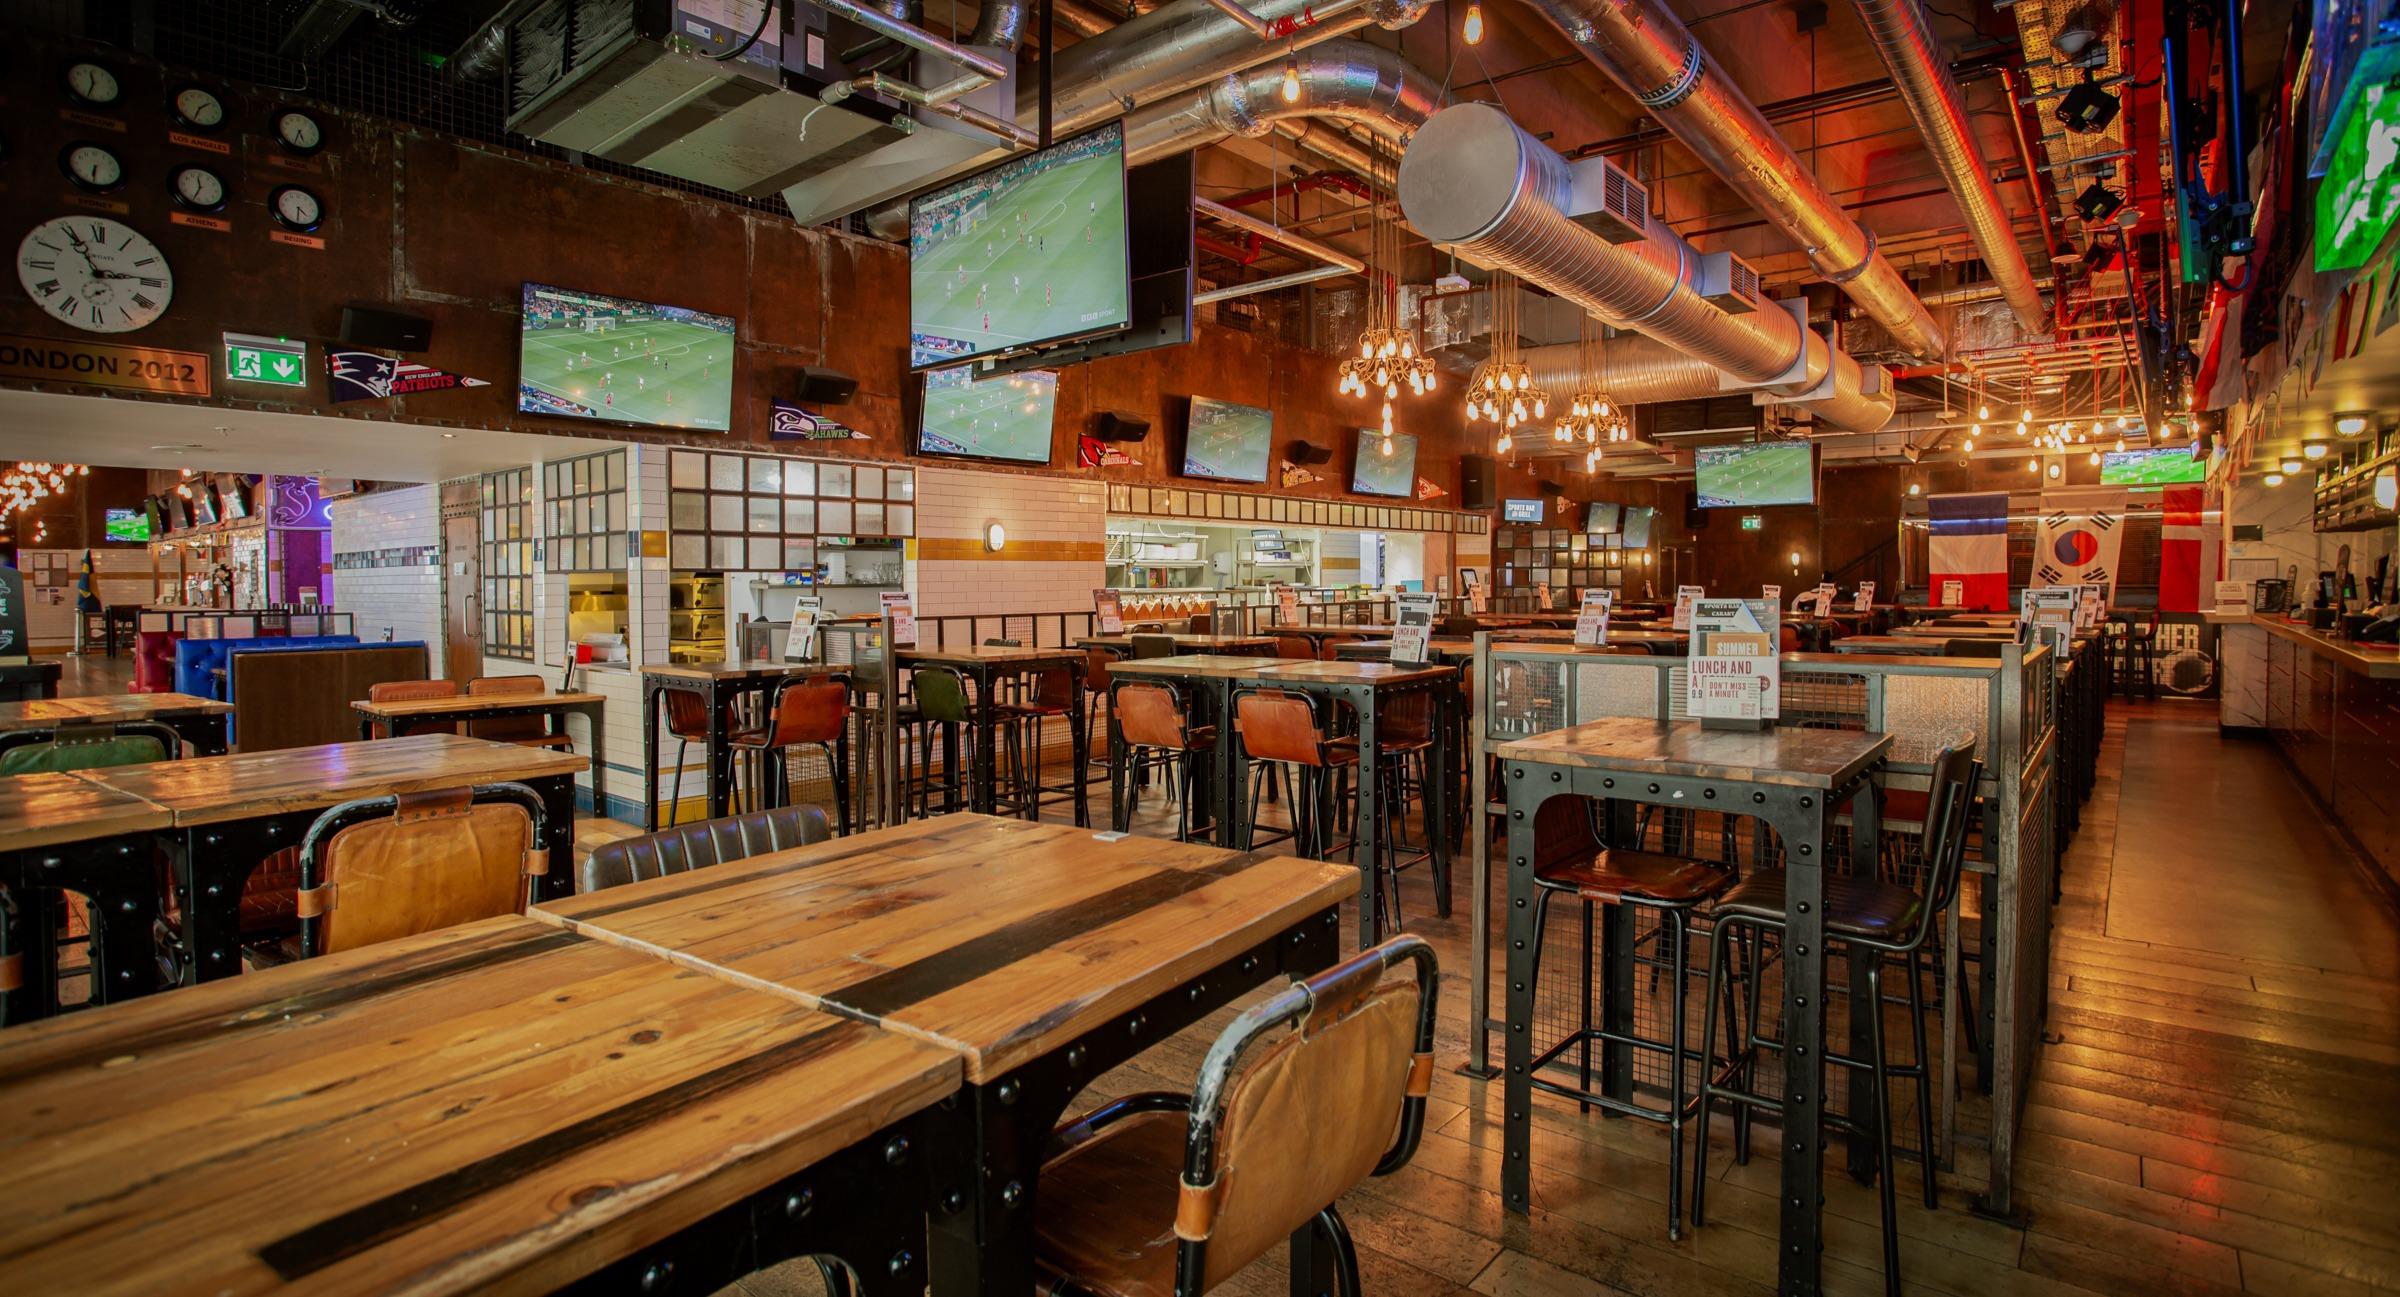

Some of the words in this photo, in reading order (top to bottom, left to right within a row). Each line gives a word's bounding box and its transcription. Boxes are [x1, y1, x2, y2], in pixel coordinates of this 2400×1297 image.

[173, 134, 189, 145] LOS
[191, 138, 228, 152] ANGELES
[185, 217, 218, 228] ATHENS
[284, 235, 313, 246] BEIJING
[1081, 312, 1098, 322] BBC
[128, 359, 196, 382] 2012
[418, 371, 443, 379] ENGLAND
[392, 375, 455, 394] PATRIOTS
[805, 429, 849, 439] SEAHAWKS
[1100, 456, 1129, 465] CARDINALS
[1717, 642, 1759, 656] SUMMER
[1692, 660, 1727, 674] LUNCH
[1730, 661, 1752, 675] AND
[1709, 681, 1728, 690] DON'T
[1730, 682, 1747, 691] MISS
[1709, 690, 1713, 698] A
[1714, 690, 1739, 699] MINUTE
